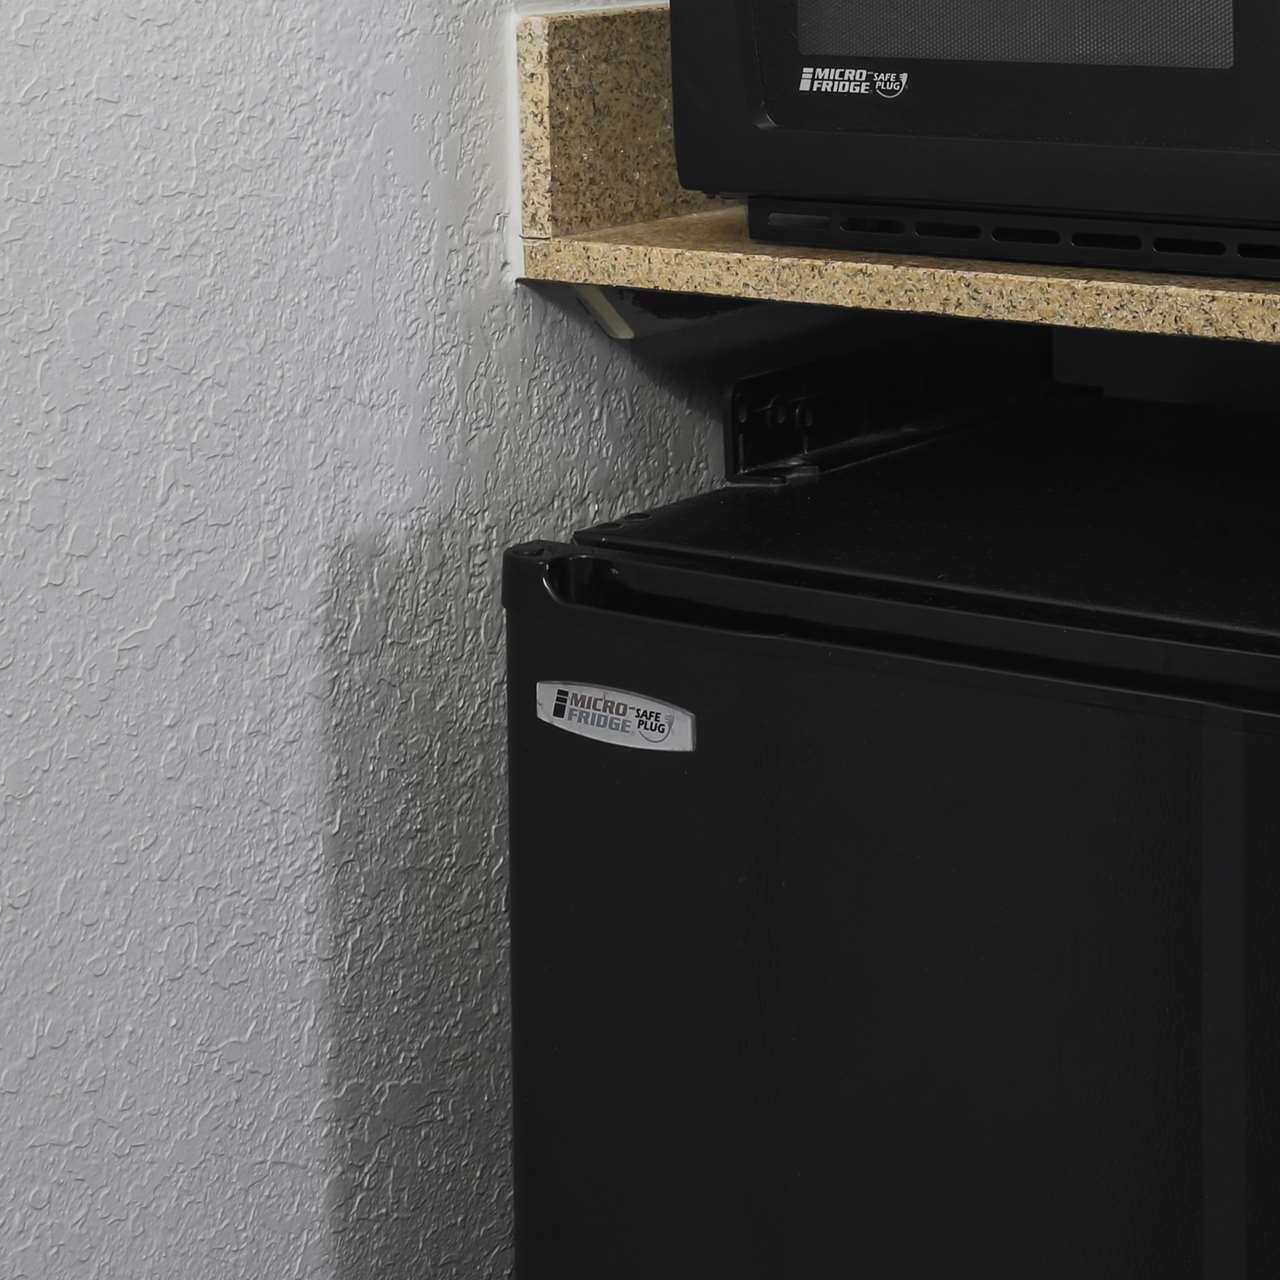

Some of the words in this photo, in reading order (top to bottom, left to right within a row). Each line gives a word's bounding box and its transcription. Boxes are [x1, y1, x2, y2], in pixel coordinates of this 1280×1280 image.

[874, 72, 897, 82] SAFE
[812, 80, 871, 94] FRIDGE
[875, 81, 901, 91] PLUG
[567, 708, 633, 734] FRIDGE
[635, 708, 662, 723] SAFE
[637, 719, 666, 734] PLUG
